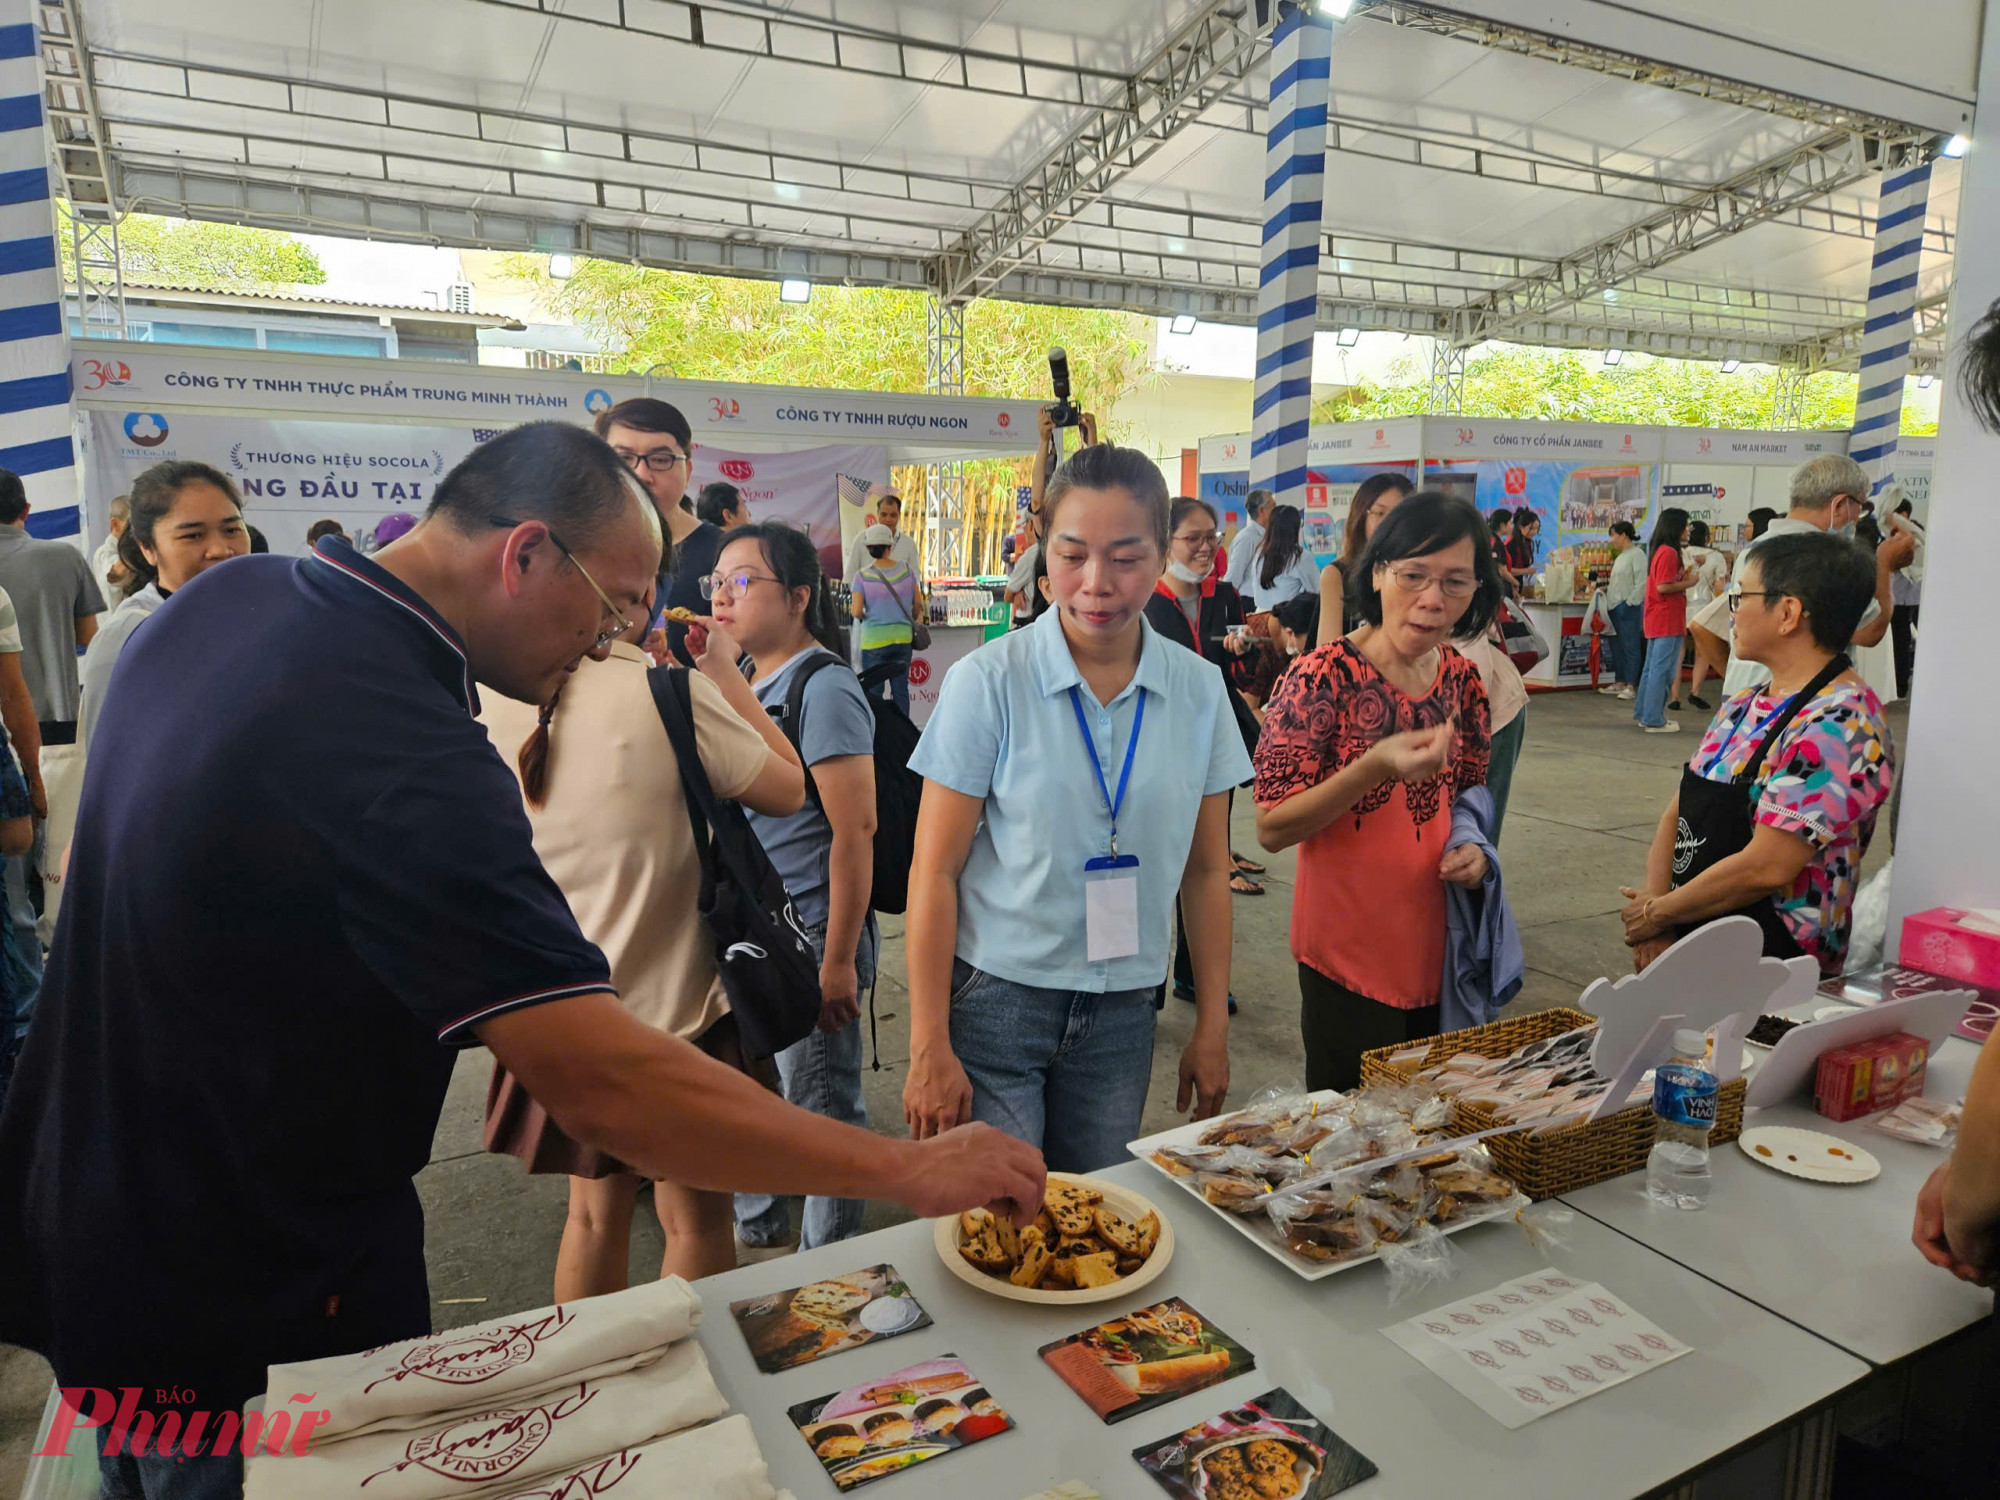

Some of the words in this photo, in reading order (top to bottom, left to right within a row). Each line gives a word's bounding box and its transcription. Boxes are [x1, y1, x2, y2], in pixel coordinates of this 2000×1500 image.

[164, 371, 219, 388] CÔNG
[224, 377, 247, 390] TY
[253, 378, 302, 393] TNHH
[307, 381, 355, 399] THỰC
[360, 379, 408, 399] PHẨM
[412, 387, 467, 402] TRUNG
[472, 391, 511, 405] MINH
[515, 392, 568, 408] THÀNH
[776, 405, 819, 422] CÔNG
[823, 411, 841, 424] TY
[845, 412, 884, 425] TNHH
[887, 412, 926, 429] RƯỢU
[930, 416, 968, 429] NGON
[1321, 439, 1353, 450] JANBEE
[1493, 431, 1519, 446] CÔNG
[1520, 436, 1532, 446] TY
[1573, 438, 1603, 449] JANBEE
[121, 448, 141, 456] TMT
[1732, 443, 1748, 452] NAM
[1749, 443, 1760, 452] AN
[1761, 444, 1787, 453] MARKET
[246, 452, 317, 465] THƯƠNG
[323, 453, 362, 469] HIỆU
[368, 456, 430, 468] SOCOLA
[241, 478, 287, 497] NG
[300, 472, 358, 498] ĐẦU
[371, 481, 423, 504] TẠI
[740, 488, 774, 502] Ngon
[919, 689, 940, 703] Ngo
[45, 872, 62, 884] Ng
[440, 1421, 545, 1475] CALIFORNIA
